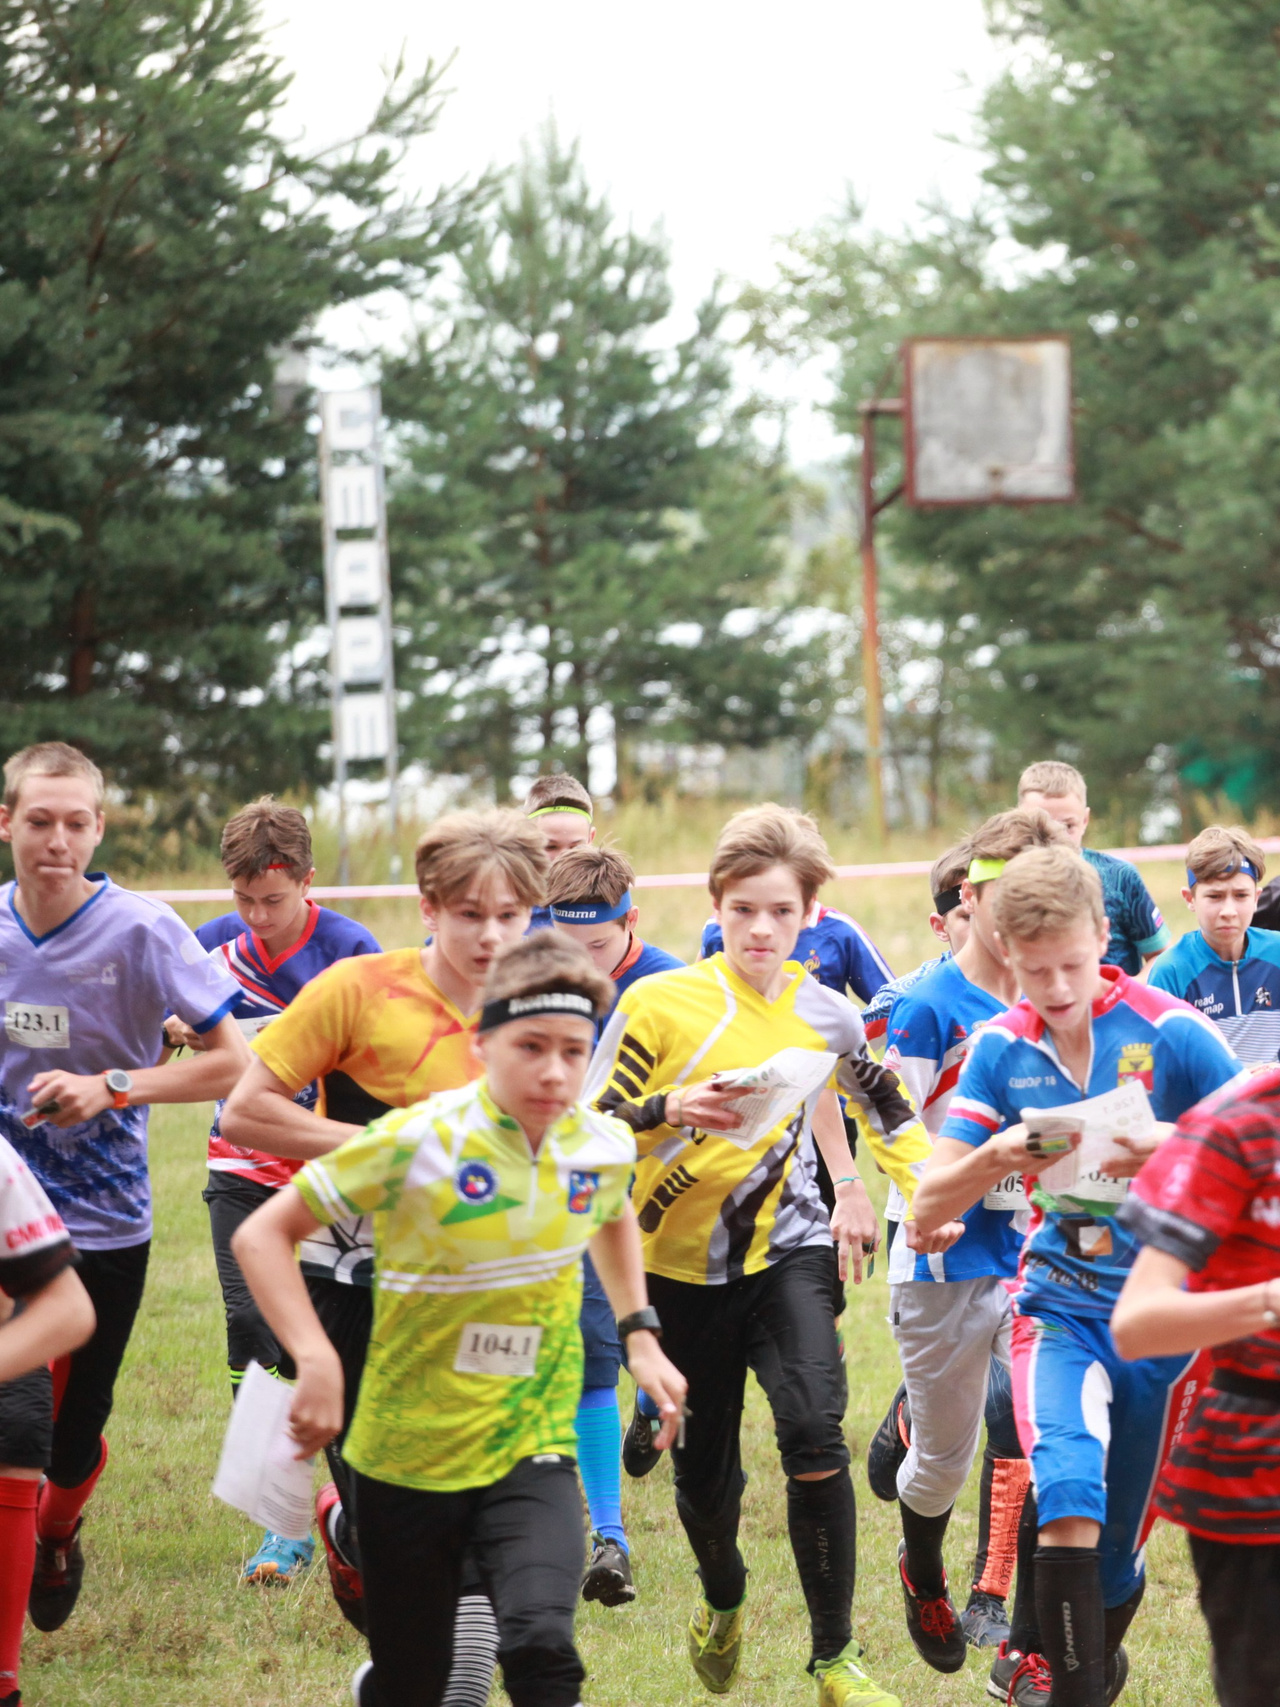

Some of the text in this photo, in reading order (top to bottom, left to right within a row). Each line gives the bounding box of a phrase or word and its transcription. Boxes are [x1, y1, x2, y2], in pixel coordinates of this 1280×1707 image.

[1203, 1002, 1224, 1015] map
[14, 1011, 60, 1032] 123.1
[470, 1332, 532, 1356] 104.1
[1061, 1600, 1076, 1653] NORD
